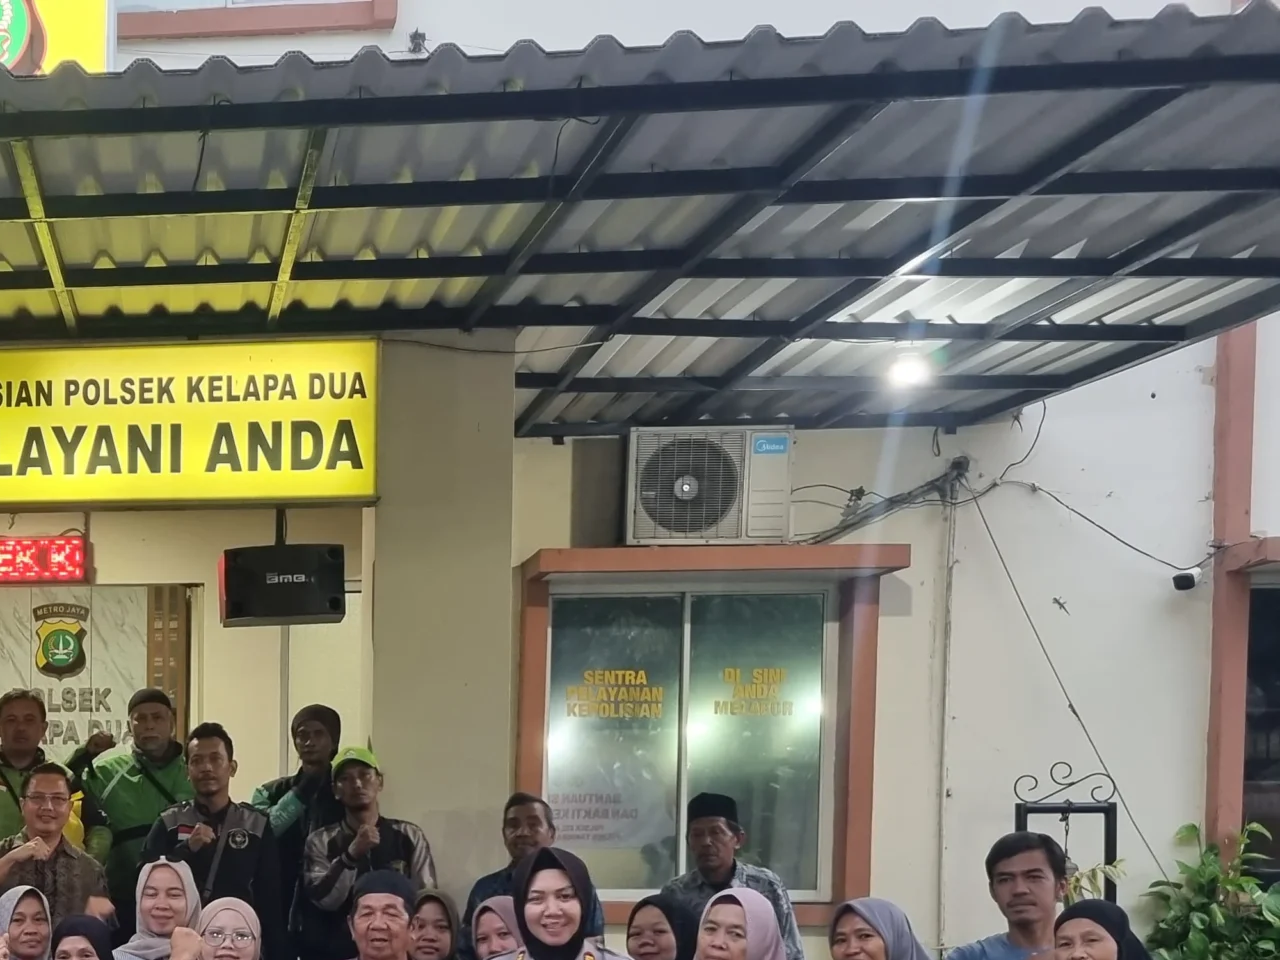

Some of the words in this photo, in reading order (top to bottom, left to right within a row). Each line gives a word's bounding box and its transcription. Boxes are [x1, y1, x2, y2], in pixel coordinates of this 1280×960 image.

[64, 376, 176, 406] POLSEK
[186, 373, 298, 403] KELAPA
[308, 371, 367, 400] DUA
[204, 418, 364, 474] ANDA
[36, 605, 65, 616] METRO
[66, 606, 85, 616] JAYA
[583, 670, 648, 685] SENTRA
[723, 668, 740, 683] DI
[566, 686, 664, 701] PELAYANAN
[566, 702, 663, 718] KEPOLISIAN
